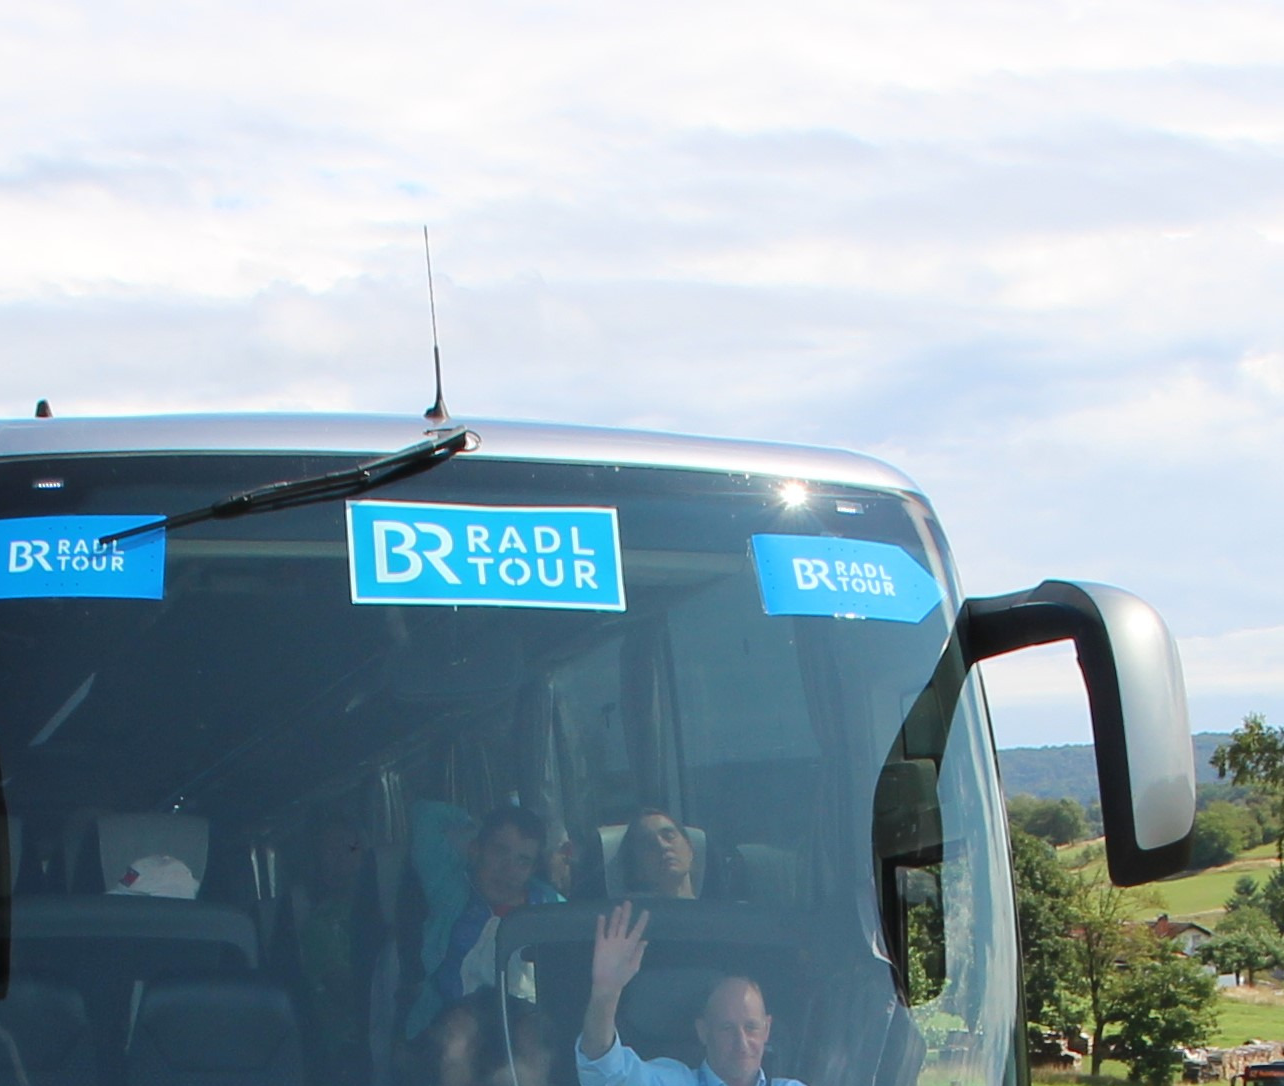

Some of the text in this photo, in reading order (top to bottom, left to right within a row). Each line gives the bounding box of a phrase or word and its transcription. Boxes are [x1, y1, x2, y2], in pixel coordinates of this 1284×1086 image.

[8, 540, 53, 572] BR
[58, 539, 124, 554] RADL
[371, 519, 462, 585] BR
[466, 525, 595, 556] RADL
[57, 556, 124, 571] TOUR
[467, 557, 598, 589] TOUR
[792, 558, 837, 591] BR
[835, 561, 892, 580] RADL
[837, 577, 896, 596] TOUR
